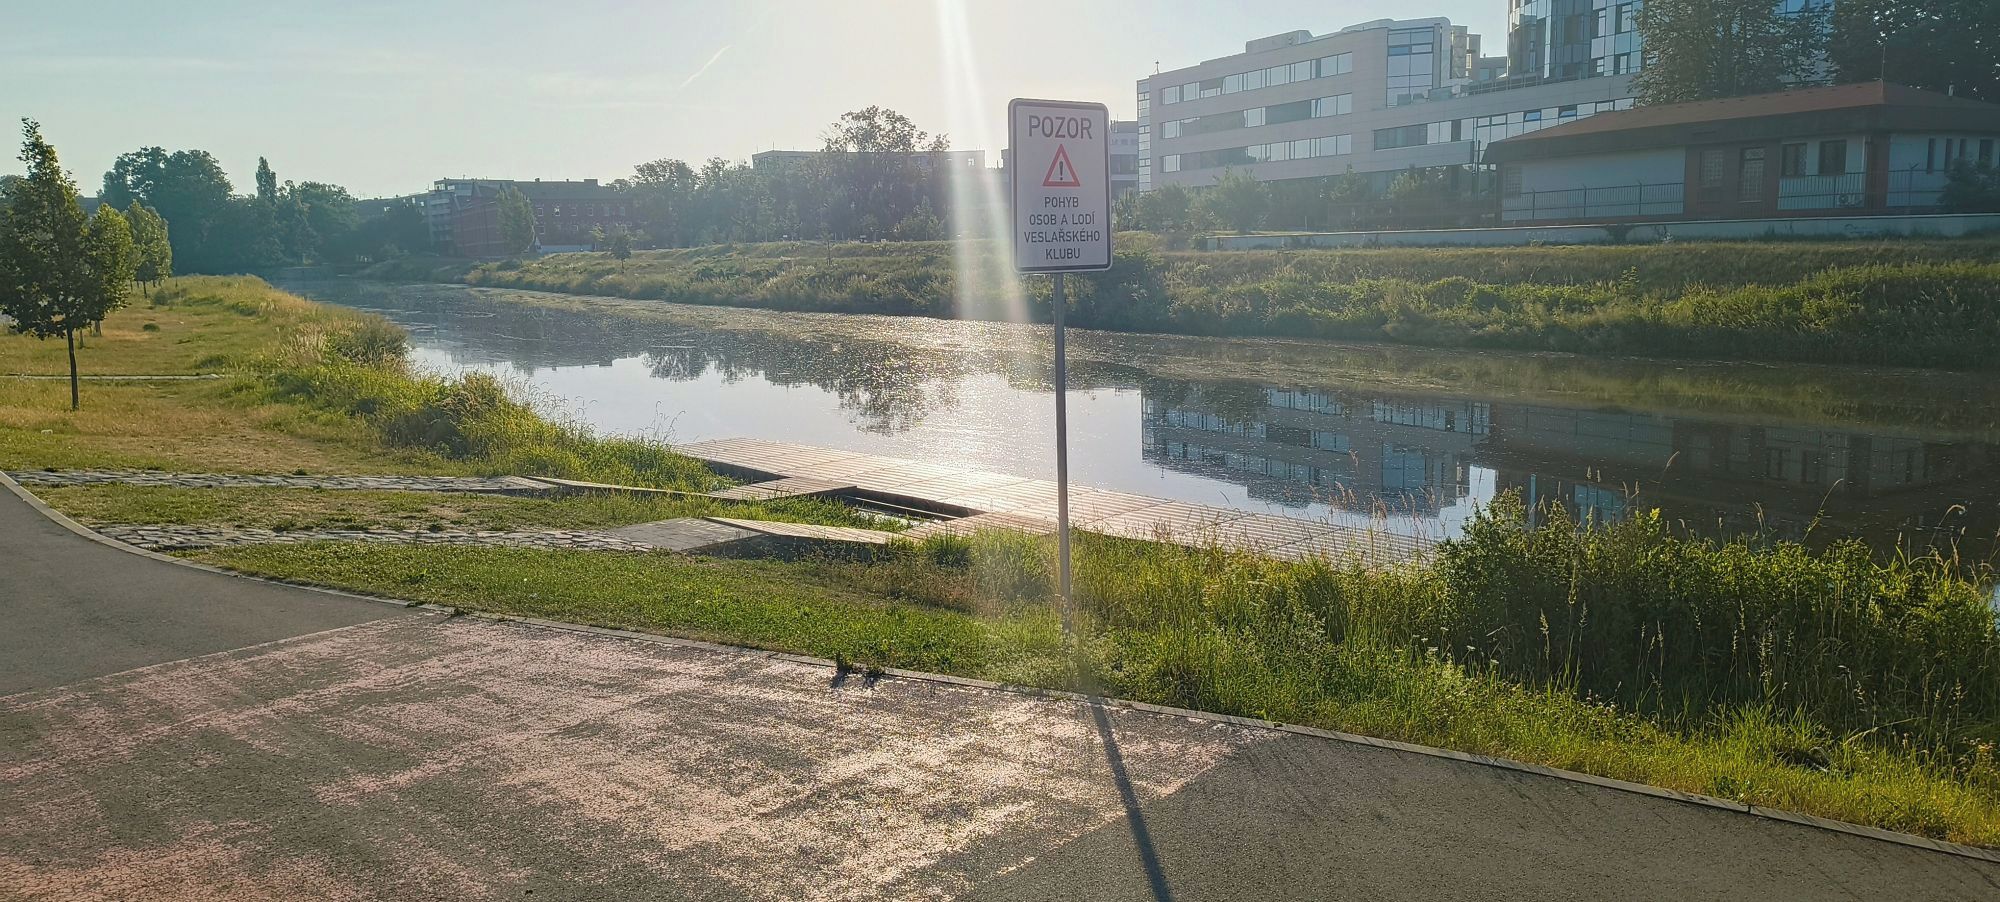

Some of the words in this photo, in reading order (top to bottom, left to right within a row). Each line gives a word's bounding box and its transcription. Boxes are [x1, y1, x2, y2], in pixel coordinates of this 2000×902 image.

[1028, 115, 1092, 139] POZOR
[1044, 196, 1079, 208] POHYB
[1029, 214, 1057, 225] OSOB
[1060, 214, 1068, 225] A
[1071, 211, 1095, 225] LODÍ
[1024, 228, 1100, 243] VESLAŘSKÉHO
[1045, 248, 1081, 260] KLUBU
